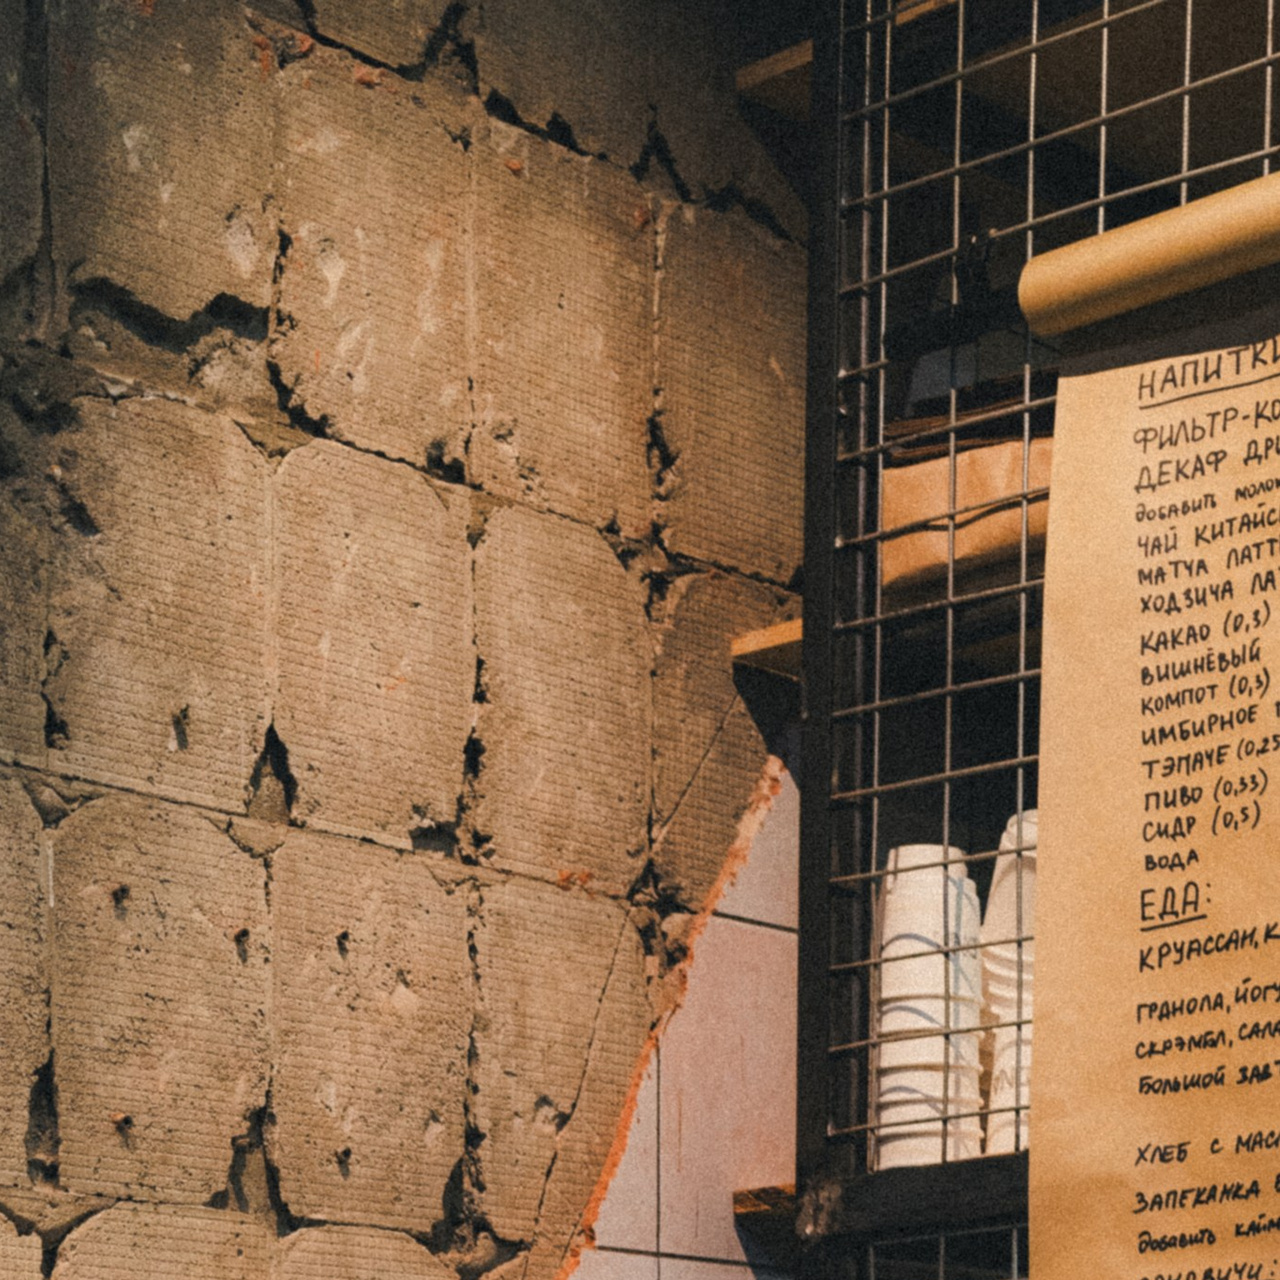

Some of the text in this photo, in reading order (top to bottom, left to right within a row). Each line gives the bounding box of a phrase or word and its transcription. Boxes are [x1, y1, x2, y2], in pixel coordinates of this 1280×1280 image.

[1134, 449, 1227, 493] ДЕКАФ
[1138, 502, 1280, 558] ЧАЙ КИТАЙС
[1137, 537, 1280, 586] МАТЧА ЛАТТ
[1140, 566, 1280, 616] ХОДЗИЧА ЛА
[1140, 599, 1271, 656] КАКАО (0,3)
[1140, 637, 1261, 686] ВИШНЁВЫЙ
[1141, 667, 1270, 716] КОМПОТ (0,3)
[1141, 704, 1258, 746] ИМБИРНОЕ
[1141, 744, 1231, 779] ТЭПАЧЕ
[1144, 767, 1268, 812] ПИВО (0,33)
[1143, 800, 1260, 842] СИДР (0,5)
[1144, 849, 1199, 872] ВОДА
[1140, 881, 1211, 921] ЕДА:
[1139, 1060, 1280, 1095] БОЛЬШОЙ ЗАВ
[1135, 1141, 1192, 1166] ХЛЕБ
[1133, 1180, 1260, 1214] ЗАПЕКАНКА
